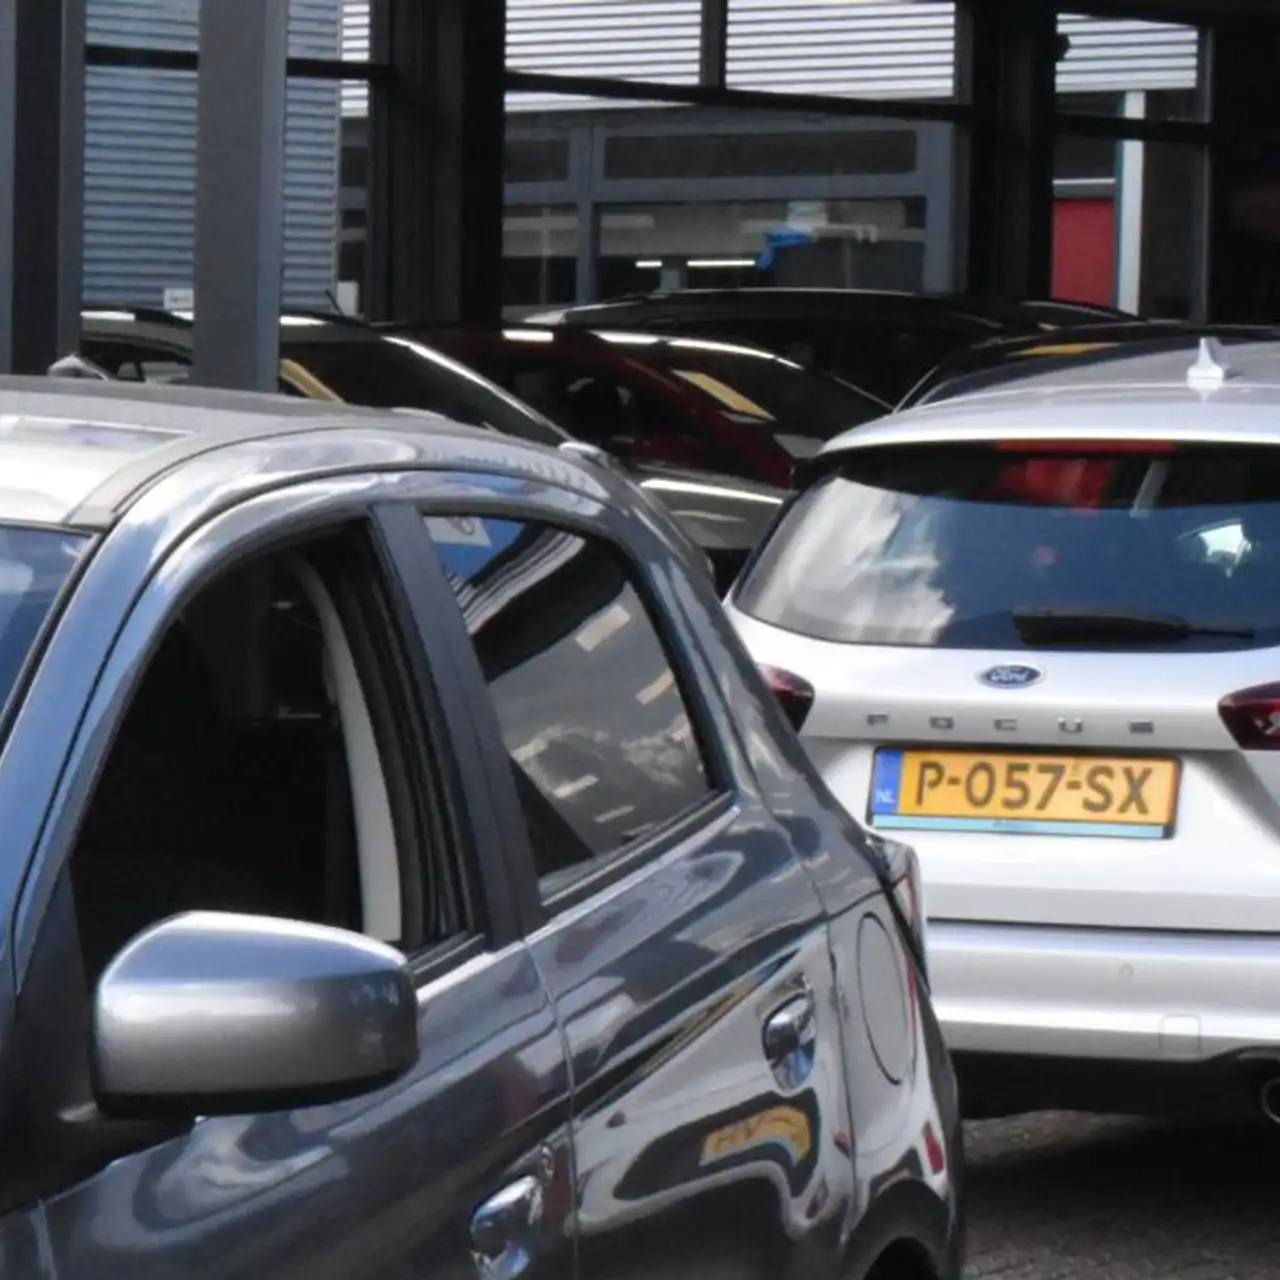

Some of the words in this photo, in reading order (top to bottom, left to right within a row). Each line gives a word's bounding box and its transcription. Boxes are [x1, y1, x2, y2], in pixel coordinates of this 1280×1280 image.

[866, 713, 1155, 735] FOCUS
[876, 788, 895, 804] NL
[915, 760, 1153, 815] P-057-SX
